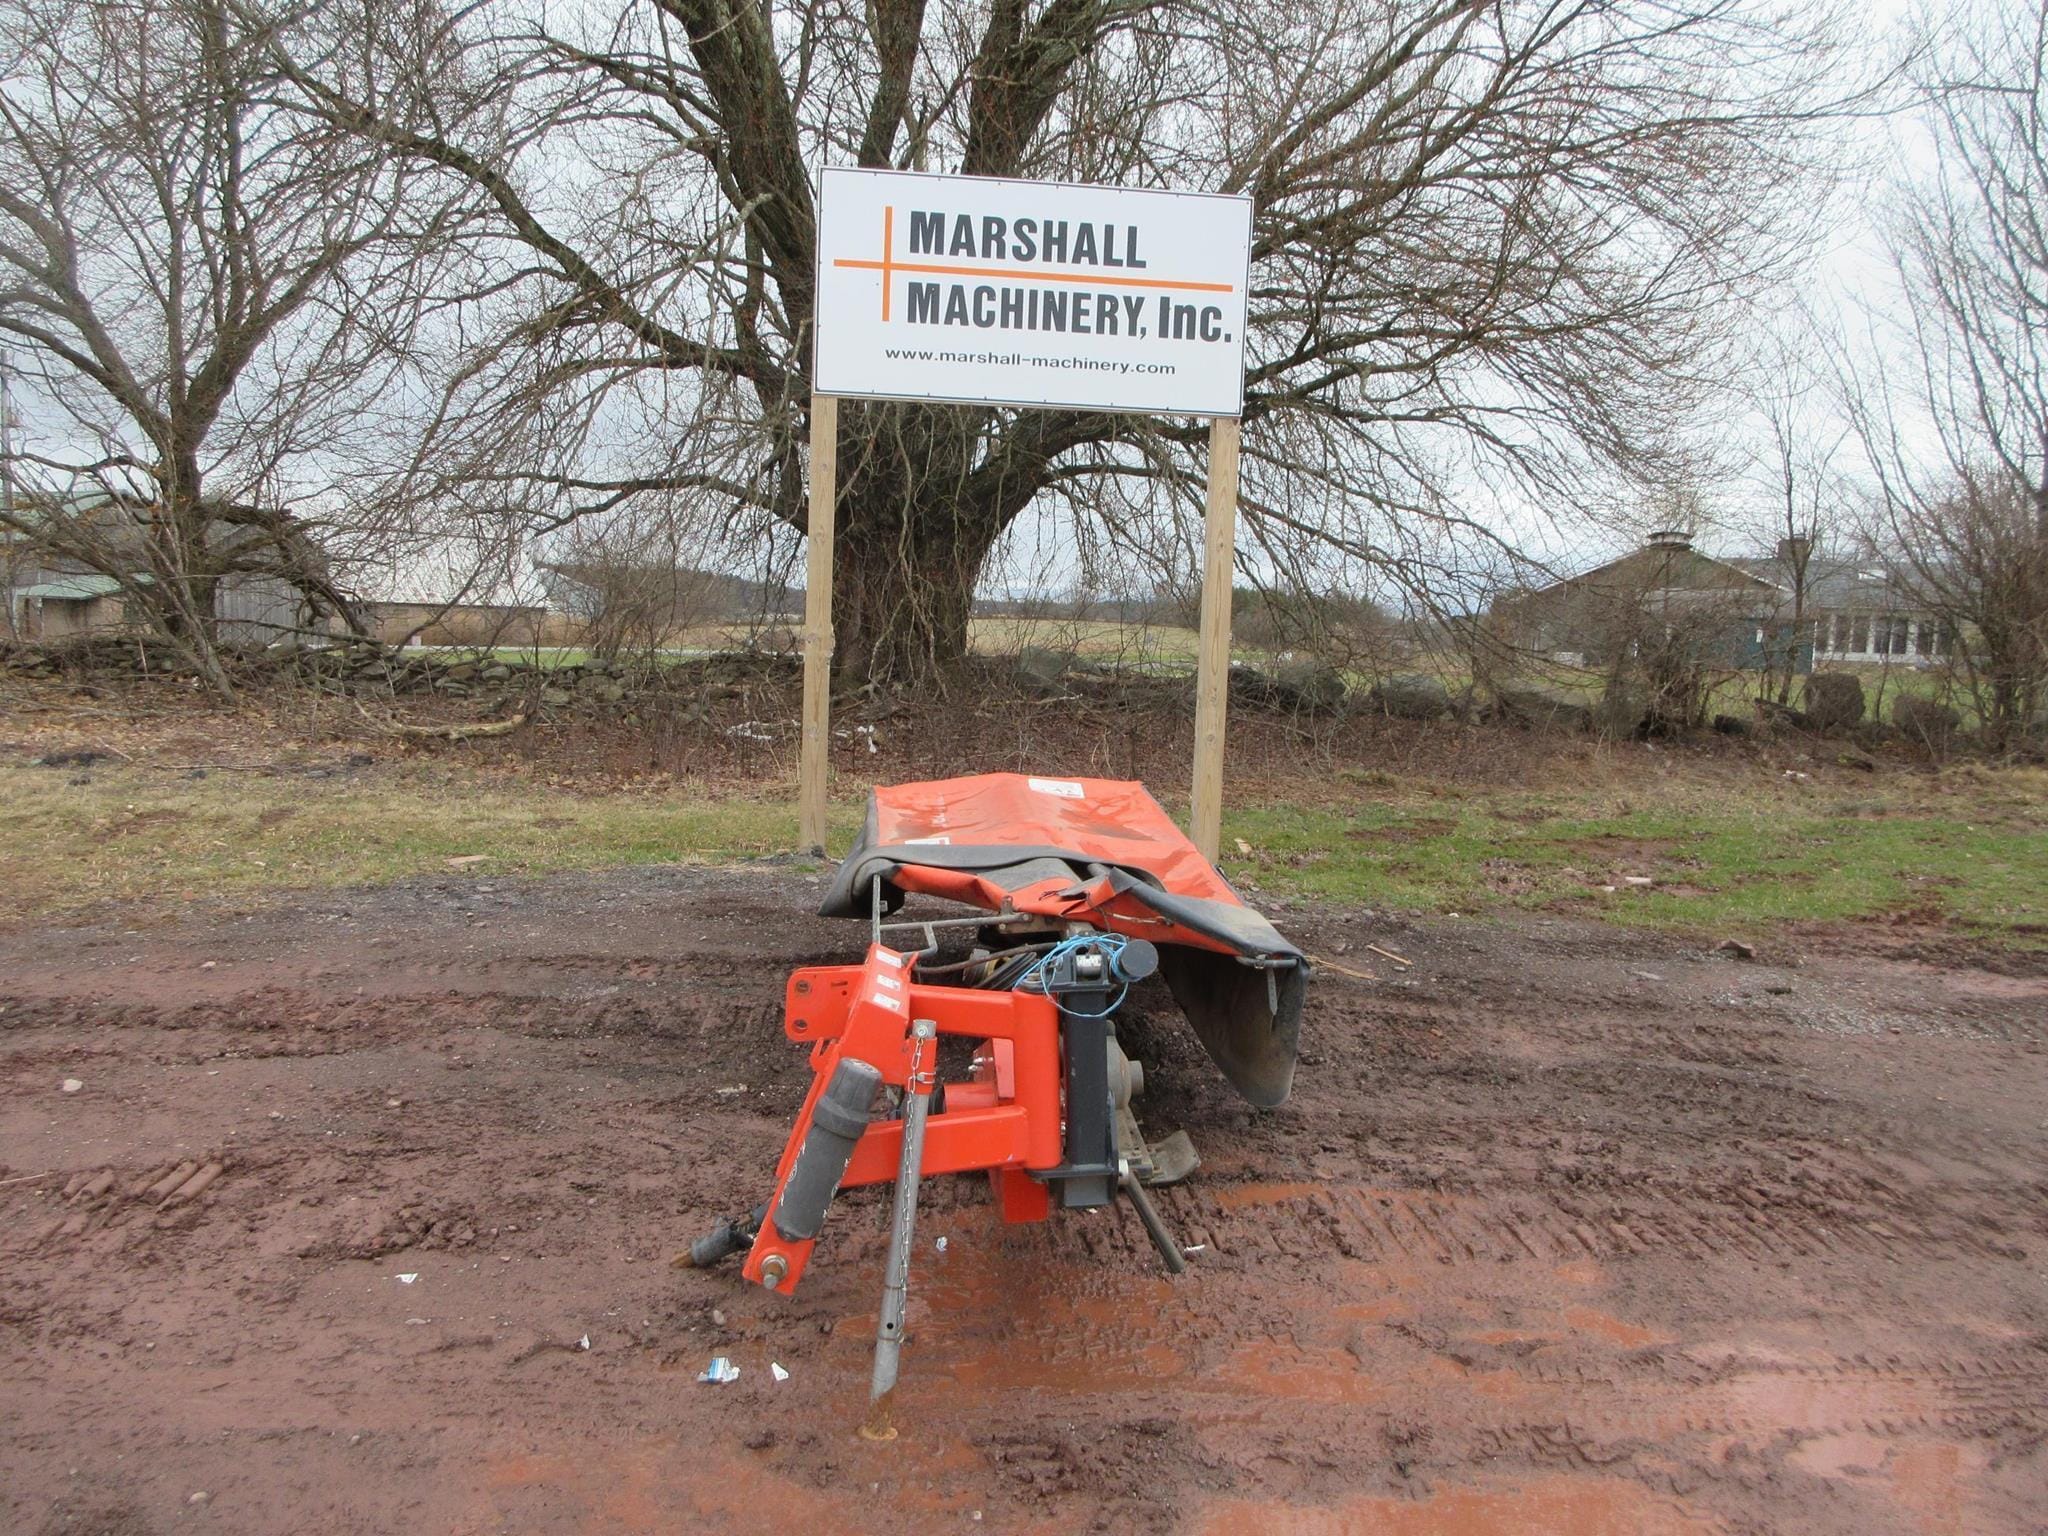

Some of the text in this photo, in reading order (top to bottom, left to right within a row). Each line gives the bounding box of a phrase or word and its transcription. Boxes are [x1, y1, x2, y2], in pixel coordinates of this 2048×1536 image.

[909, 210, 1147, 269] MARSHALL
[907, 281, 1232, 343] MACHINERY, Inc.
[885, 348, 1176, 375] www.marshall-machinery.com
